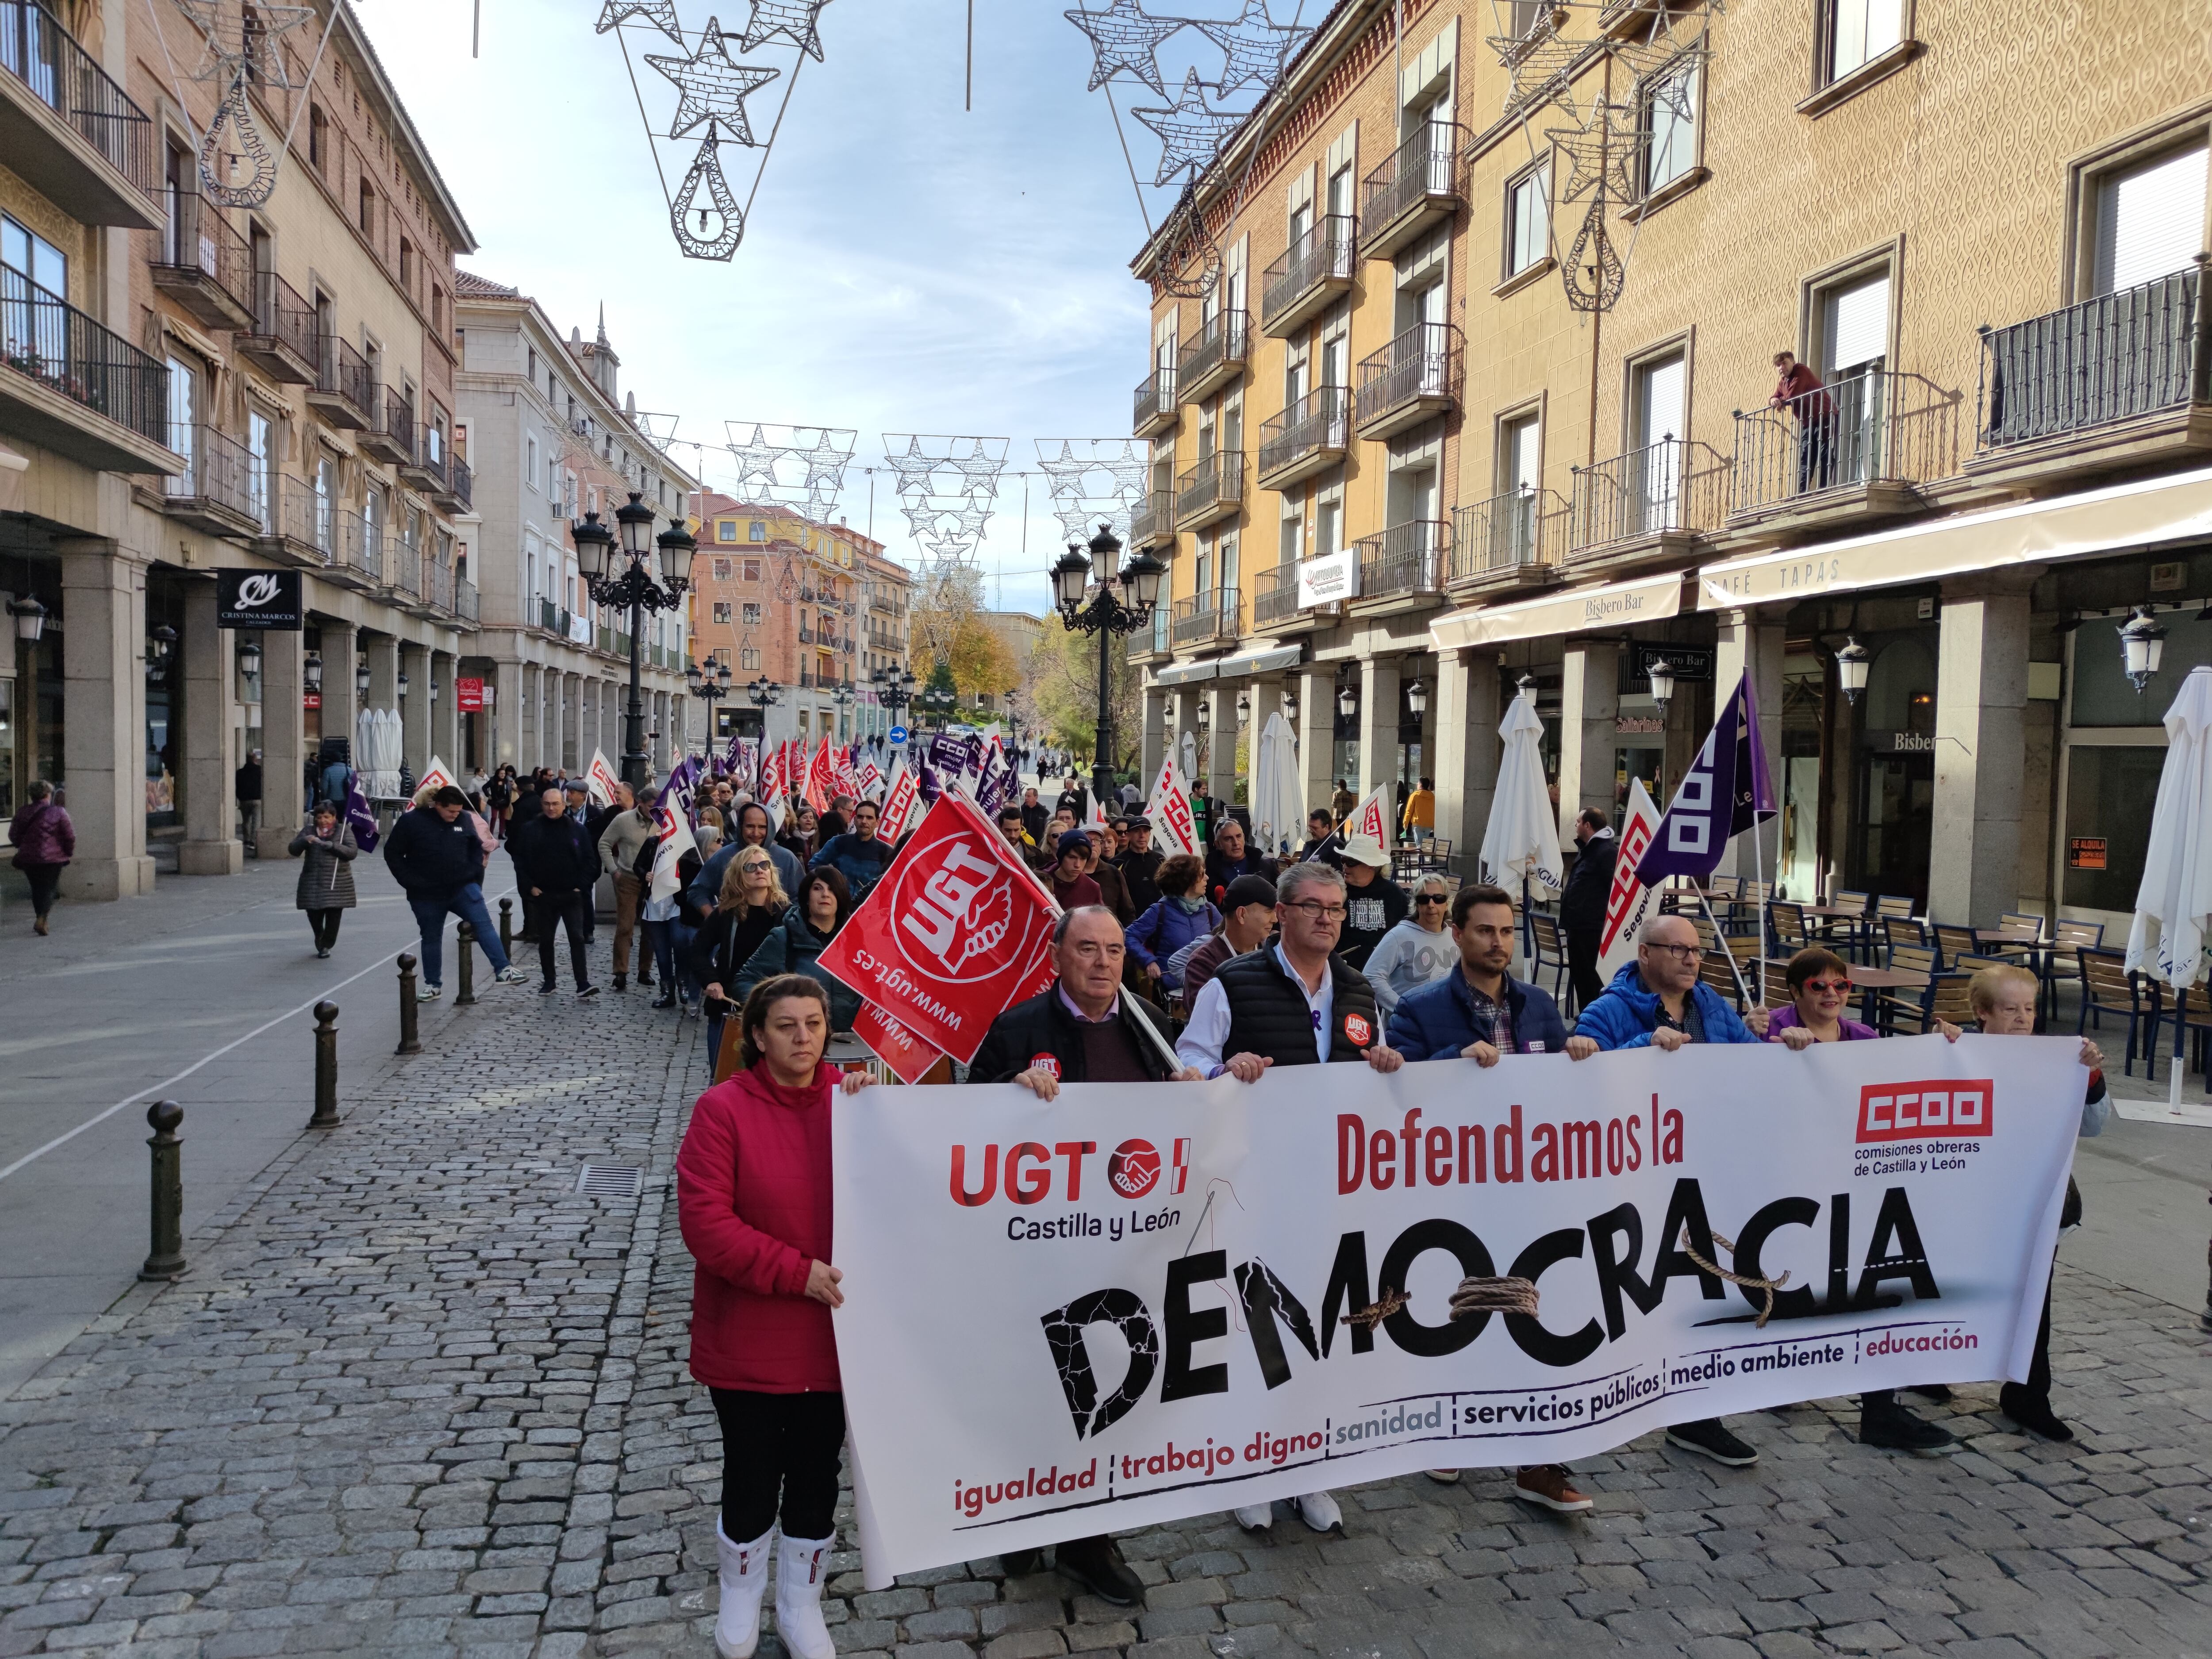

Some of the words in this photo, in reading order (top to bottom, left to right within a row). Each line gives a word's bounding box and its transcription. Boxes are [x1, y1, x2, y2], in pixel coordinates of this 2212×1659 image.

[1780, 559, 1839, 588] TAPAS
[1585, 598, 1622, 618] Bisbero
[1624, 594, 1644, 610] Bar
[1645, 653, 1683, 664] Bisero
[1686, 654, 1705, 666] Bar
[1616, 717, 1663, 733] Bailarinas
[945, 754, 962, 763] mujer
[864, 783, 876, 796] govia
[1734, 791, 1753, 807] Le
[879, 776, 914, 839] CCOO
[1158, 817, 1178, 848] Segovia
[1166, 792, 1192, 849] CCO
[2072, 840, 2079, 849] SE
[2081, 840, 2104, 850] ALQUILA
[902, 842, 1000, 956] UGT
[1356, 905, 1367, 914] NO
[1368, 905, 1379, 914] HAY
[1356, 914, 1381, 923] TREGUA
[853, 949, 962, 1031] www.ugt.es
[1348, 1016, 1368, 1035] UGT
[1031, 1058, 1056, 1073] UGT
[1866, 1091, 1984, 1131] CCOO
[1337, 1105, 1641, 1195] Defendamos
[1651, 1093, 1683, 1166] la
[1855, 1143, 1923, 1160] comisiones
[1927, 1141, 1980, 1154] obreras
[950, 1141, 1097, 1207] UGT
[1855, 1164, 1869, 1176] de
[1873, 1158, 1916, 1175] Castilla
[1920, 1160, 1928, 1173] y
[1932, 1156, 1966, 1170] León
[1008, 1212, 1102, 1241] Castilla
[1110, 1217, 1123, 1242] y
[1131, 1207, 1180, 1234] León
[1041, 1178, 1941, 1442] DEMOCRACIA
[955, 1457, 1097, 1517] igualdad
[1121, 1438, 1234, 1480] trabajo
[1244, 1432, 1323, 1465] digno
[1336, 1401, 1441, 1444] sanidad
[1464, 1395, 1583, 1424] servicios
[1591, 1373, 1659, 1421] públicos
[1671, 1354, 1735, 1386] medio
[1741, 1344, 1844, 1374] ambiente
[1866, 1328, 1978, 1357] educación
